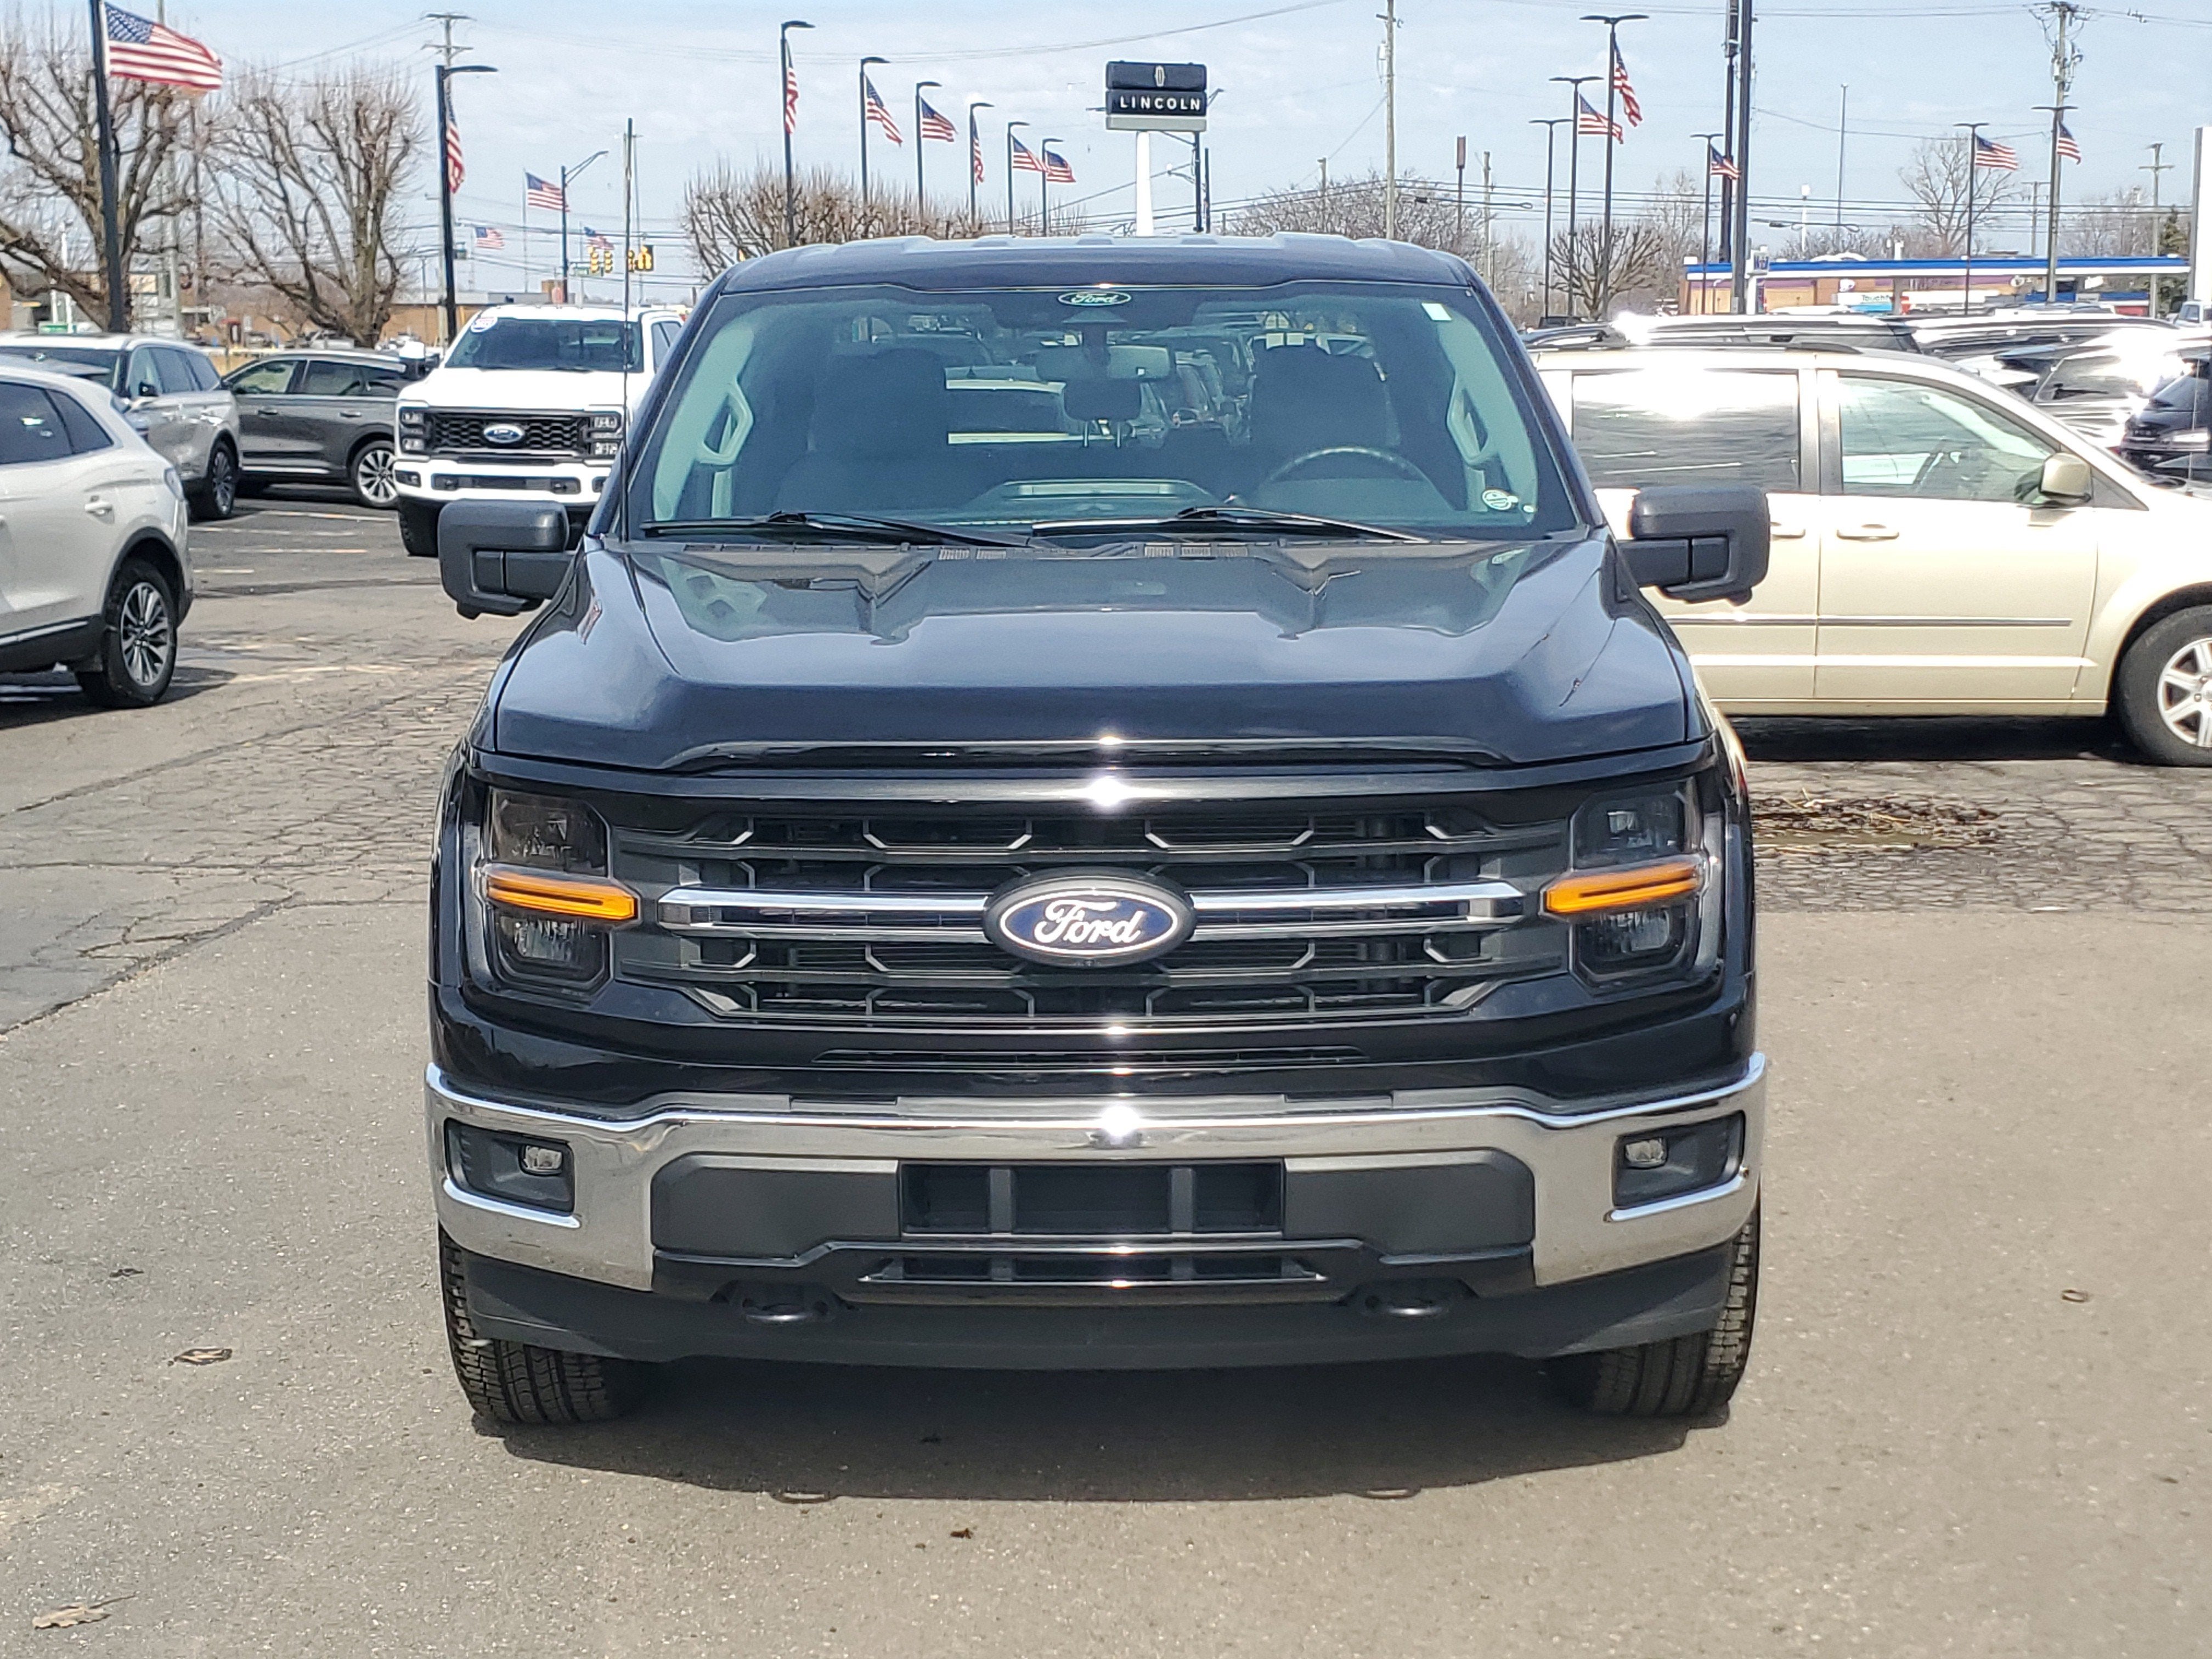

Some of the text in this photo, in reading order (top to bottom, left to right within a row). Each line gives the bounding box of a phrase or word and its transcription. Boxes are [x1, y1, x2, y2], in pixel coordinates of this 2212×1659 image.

[1119, 95, 1200, 111] LINCOLN
[1071, 291, 1118, 303] Ford
[1034, 899, 1148, 944] Ford
